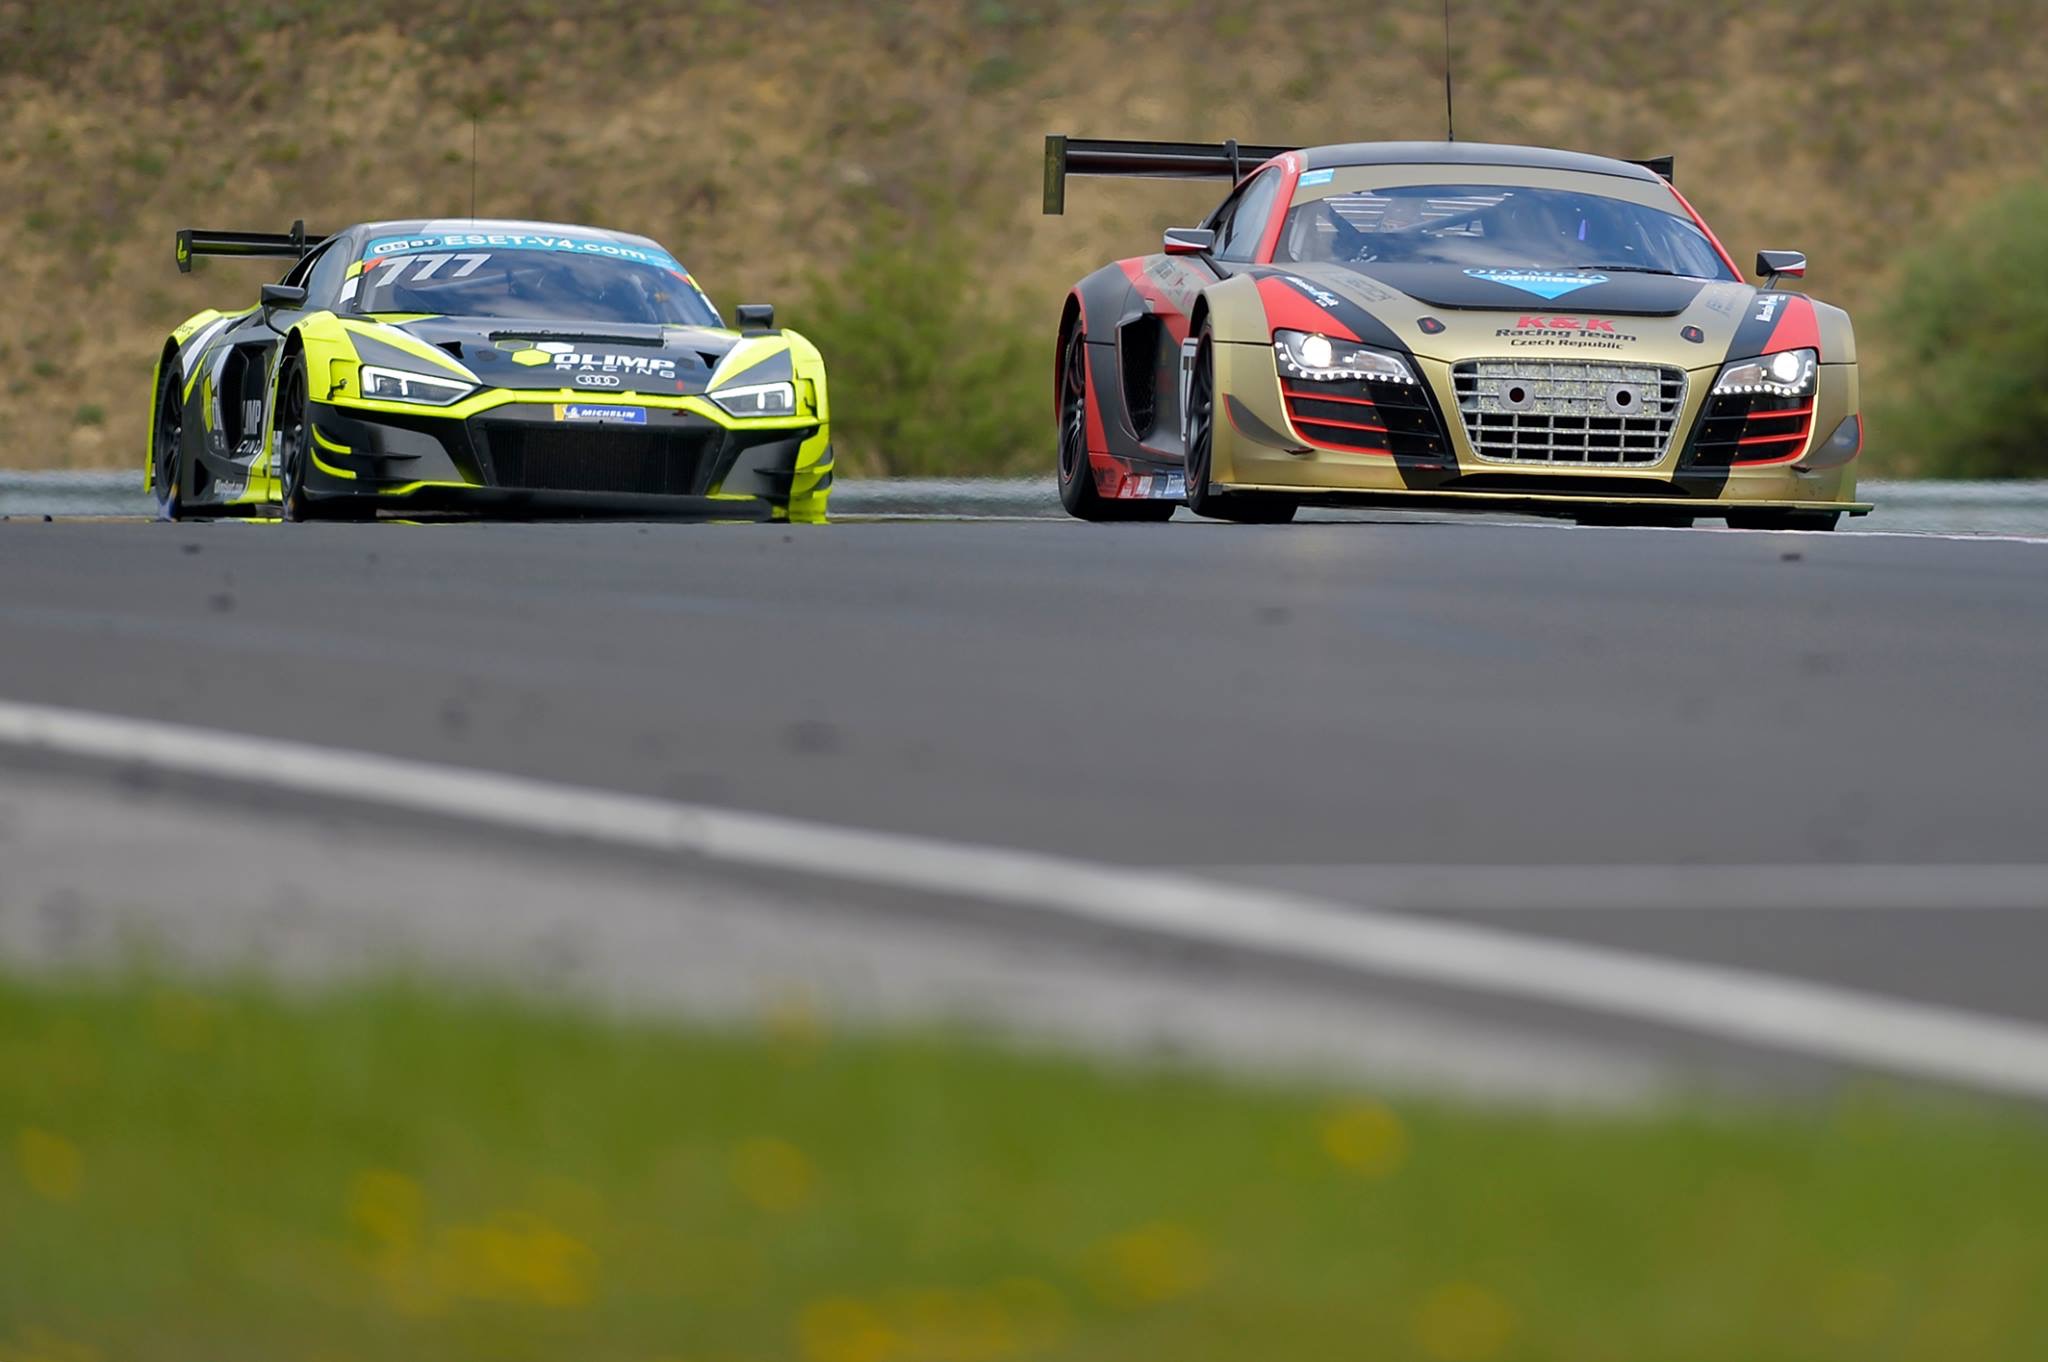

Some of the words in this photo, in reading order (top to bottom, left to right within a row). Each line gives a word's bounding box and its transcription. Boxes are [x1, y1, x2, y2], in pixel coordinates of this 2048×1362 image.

[444, 235, 647, 260] ESET-V4.com
[375, 253, 492, 287] 777
[1516, 316, 1616, 332] K&K
[1495, 328, 1571, 338] Racing
[1577, 330, 1637, 341] Team
[1510, 338, 1555, 347] Czech
[1558, 339, 1624, 350] Republic
[553, 353, 675, 369] OLIMP
[555, 363, 675, 379] RACING
[581, 407, 636, 418] MICHELIN
